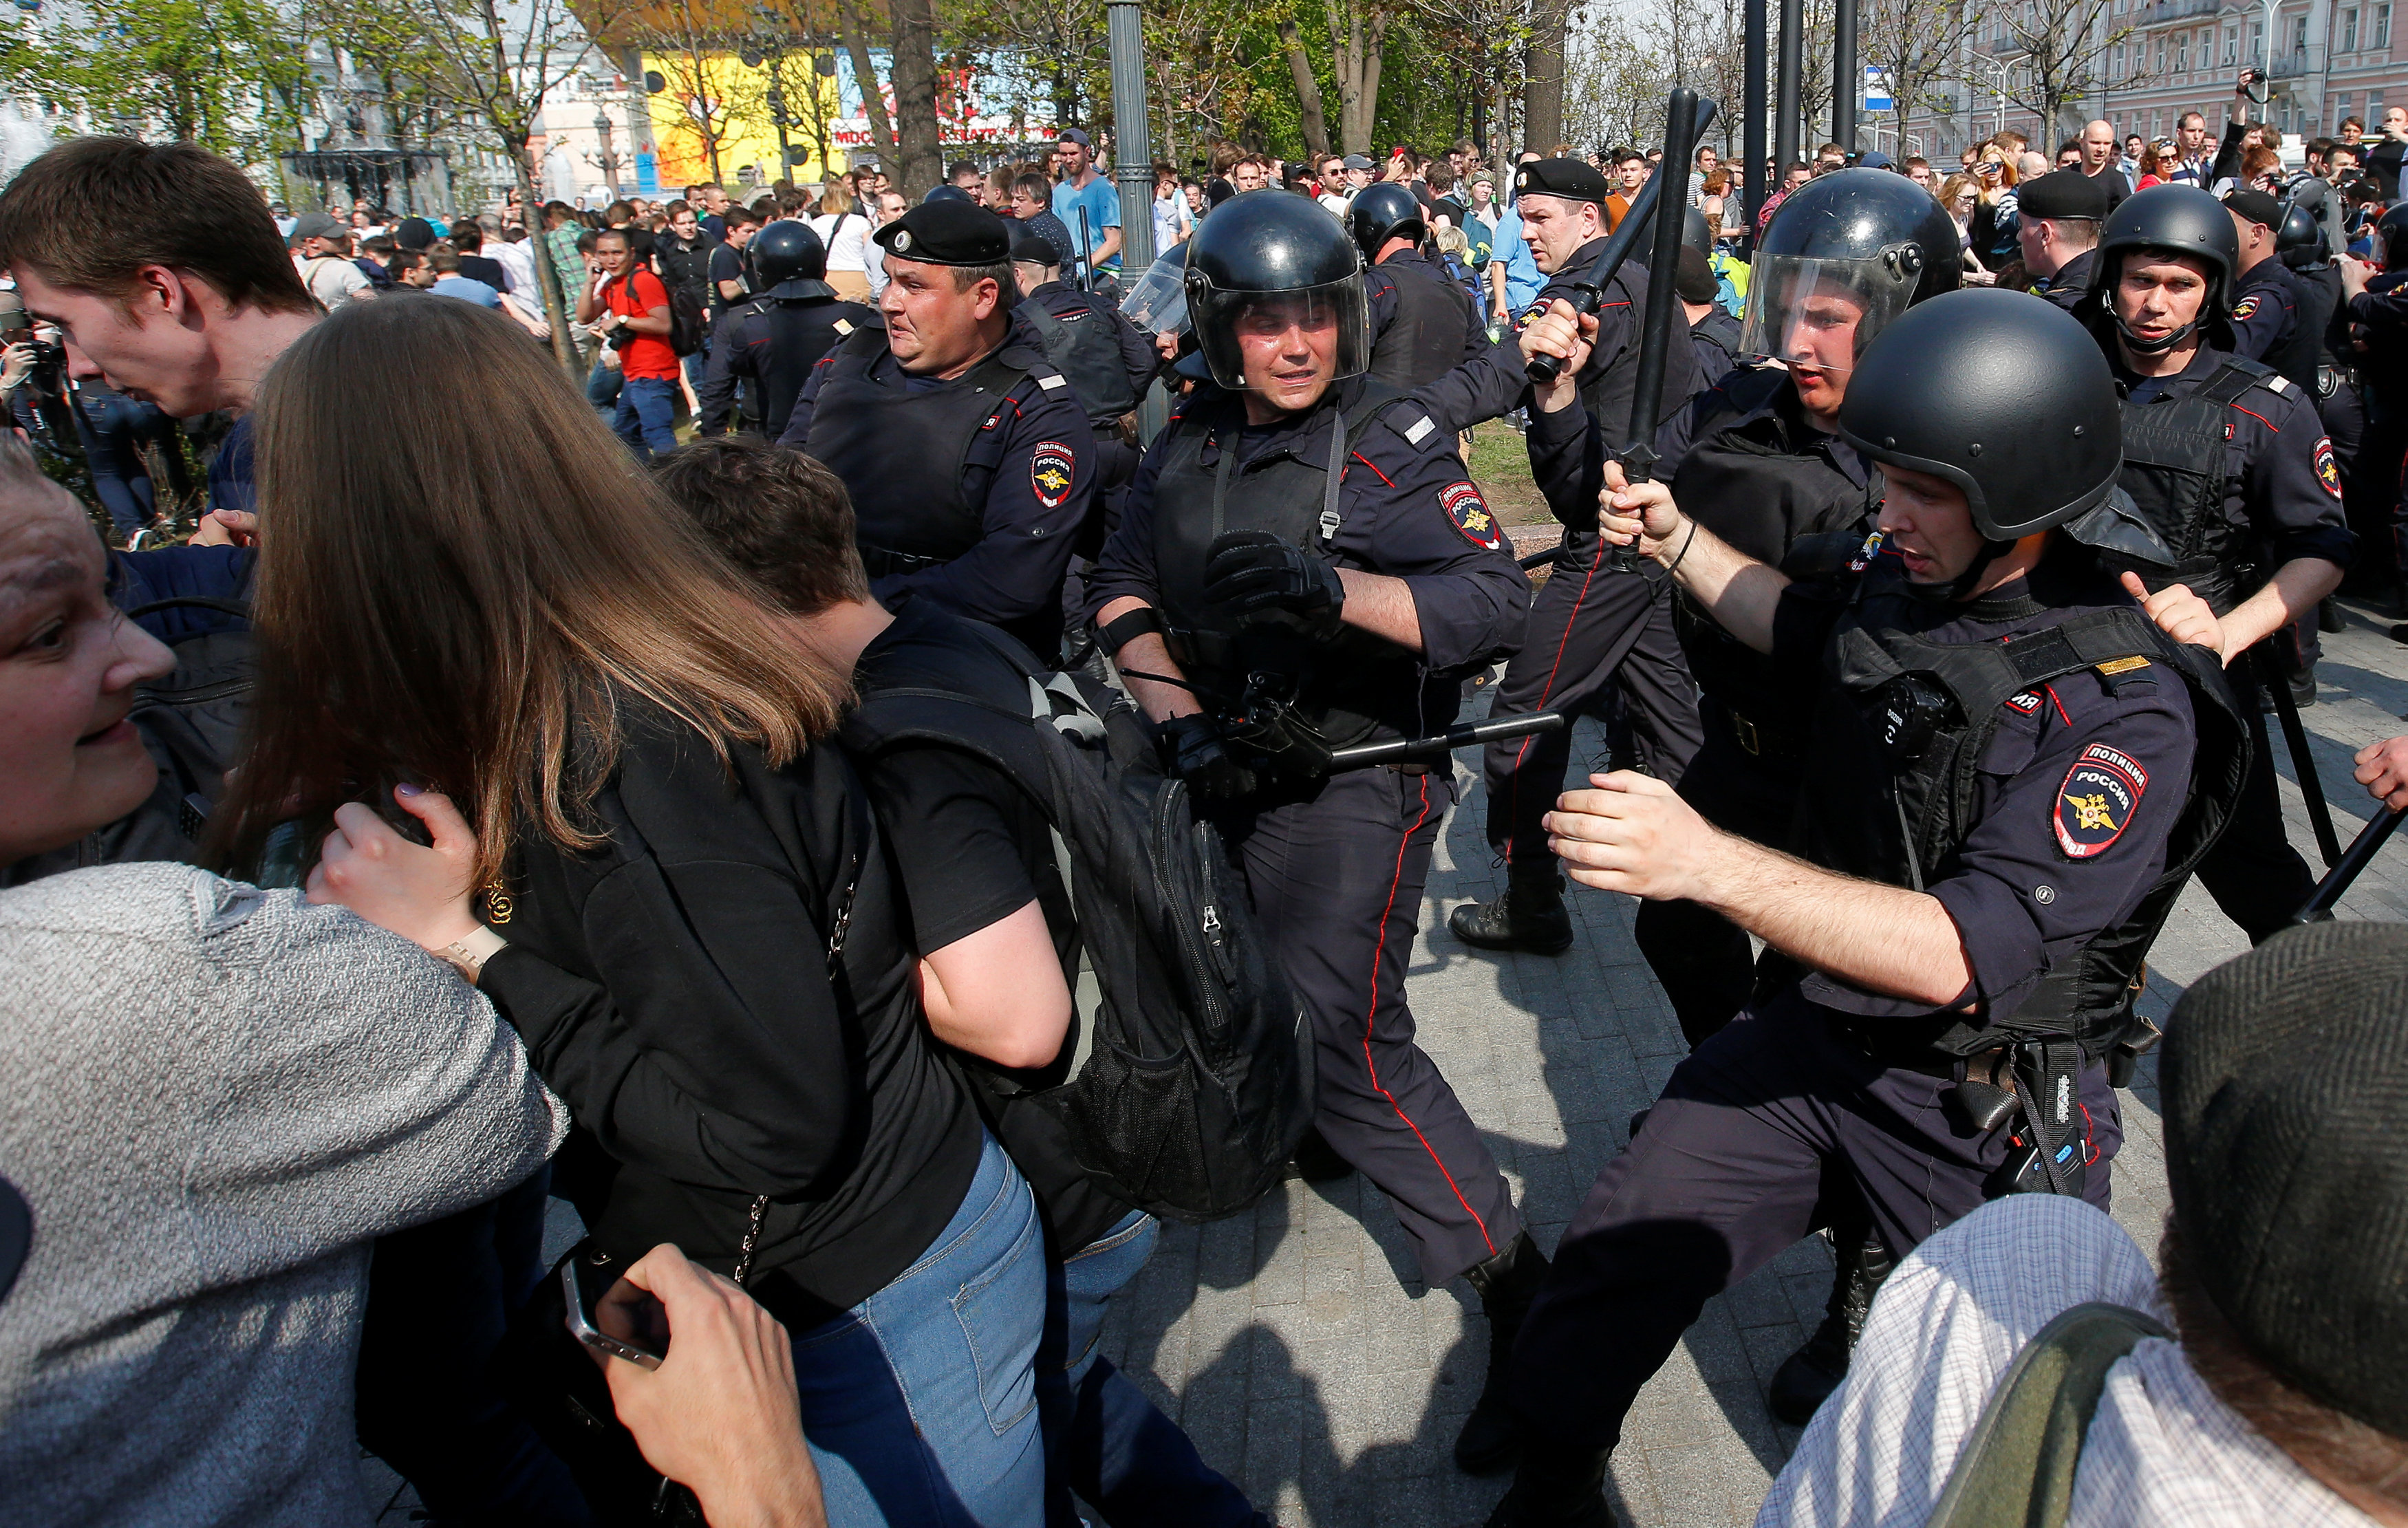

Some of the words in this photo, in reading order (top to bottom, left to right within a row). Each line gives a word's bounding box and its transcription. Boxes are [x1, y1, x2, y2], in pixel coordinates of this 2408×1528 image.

[1038, 444, 1073, 457] ПОЛИЦИЯ
[1037, 458, 1070, 473] РОССИЯ
[1042, 495, 1057, 508] МВД
[1443, 484, 1473, 502] ПОЛИЦИЯ
[1452, 497, 1481, 515] РОССИЯ
[1887, 709, 1903, 727] DOZOR
[2089, 747, 2145, 788] ПОЛИЦИЯ
[2076, 771, 2129, 811] РОССИЯ
[2061, 832, 2087, 856] МВД
